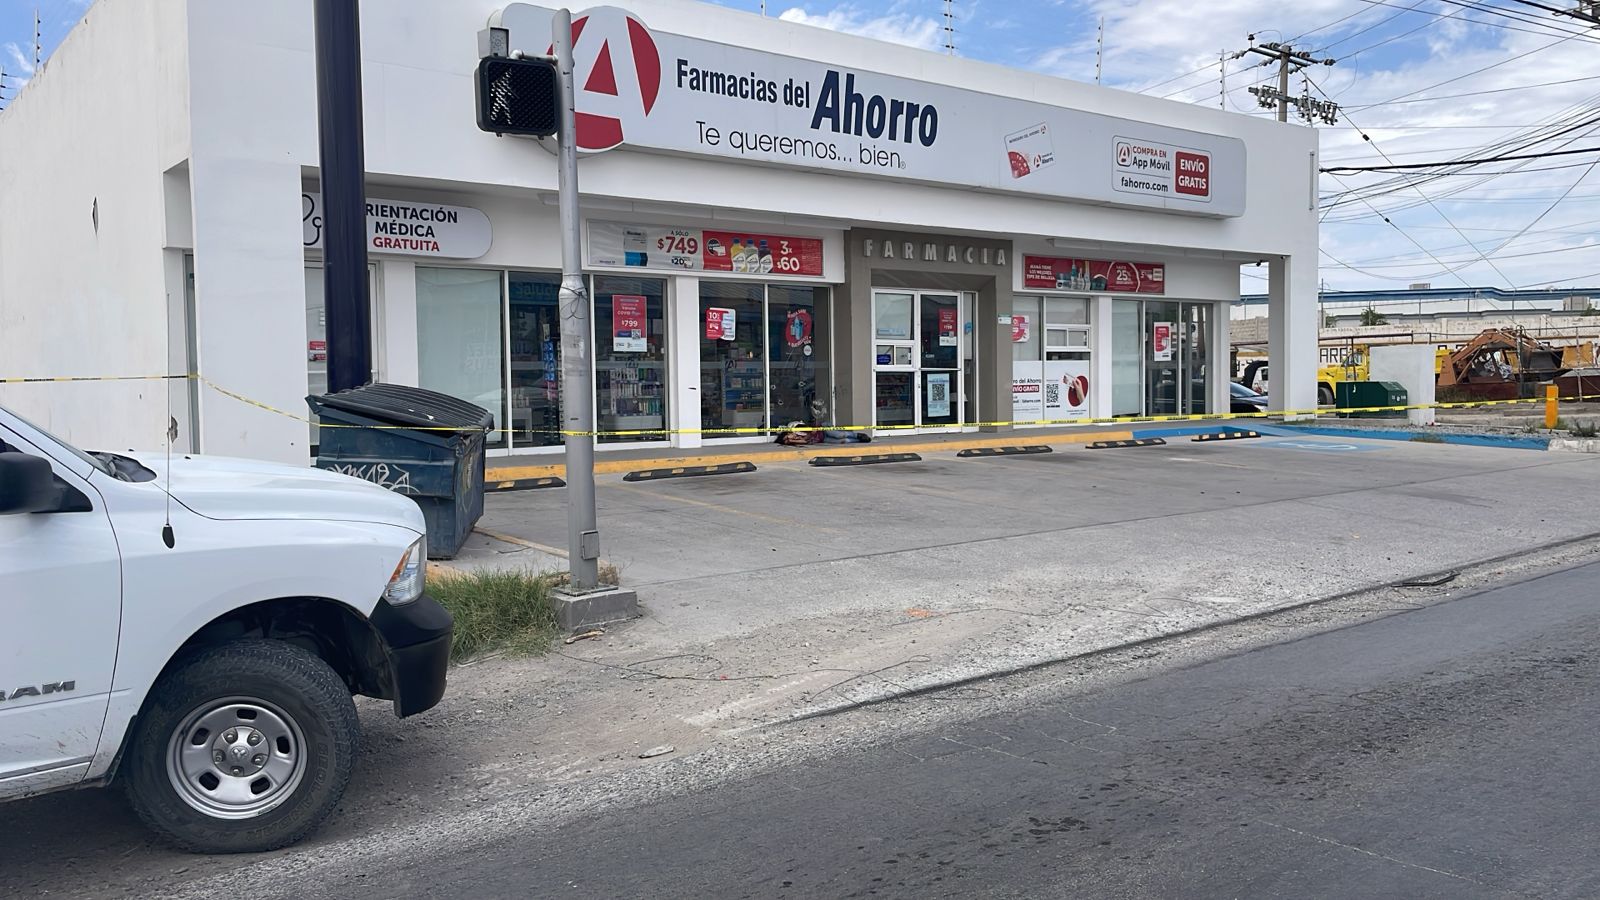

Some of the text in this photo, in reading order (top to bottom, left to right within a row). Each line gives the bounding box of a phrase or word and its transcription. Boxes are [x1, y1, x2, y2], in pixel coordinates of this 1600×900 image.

[676, 58, 939, 147] Farmacias del Ahorro
[696, 120, 721, 146] Te
[729, 130, 852, 163] queremos...
[1132, 145, 1167, 159] COMPRA EN
[1132, 156, 1171, 172] App Móvil
[1180, 158, 1205, 173] ENVÍO
[1121, 176, 1169, 193] fahorro.com
[1178, 175, 1207, 190] GRATIS
[366, 203, 458, 223] RIENTACIÓN
[375, 220, 435, 238] MÉDICA
[372, 237, 440, 252] GRATUITA
[657, 236, 698, 255] $749
[864, 239, 1006, 266] FARMACIA
[777, 256, 800, 272] $60
[0, 680, 76, 701] AM
